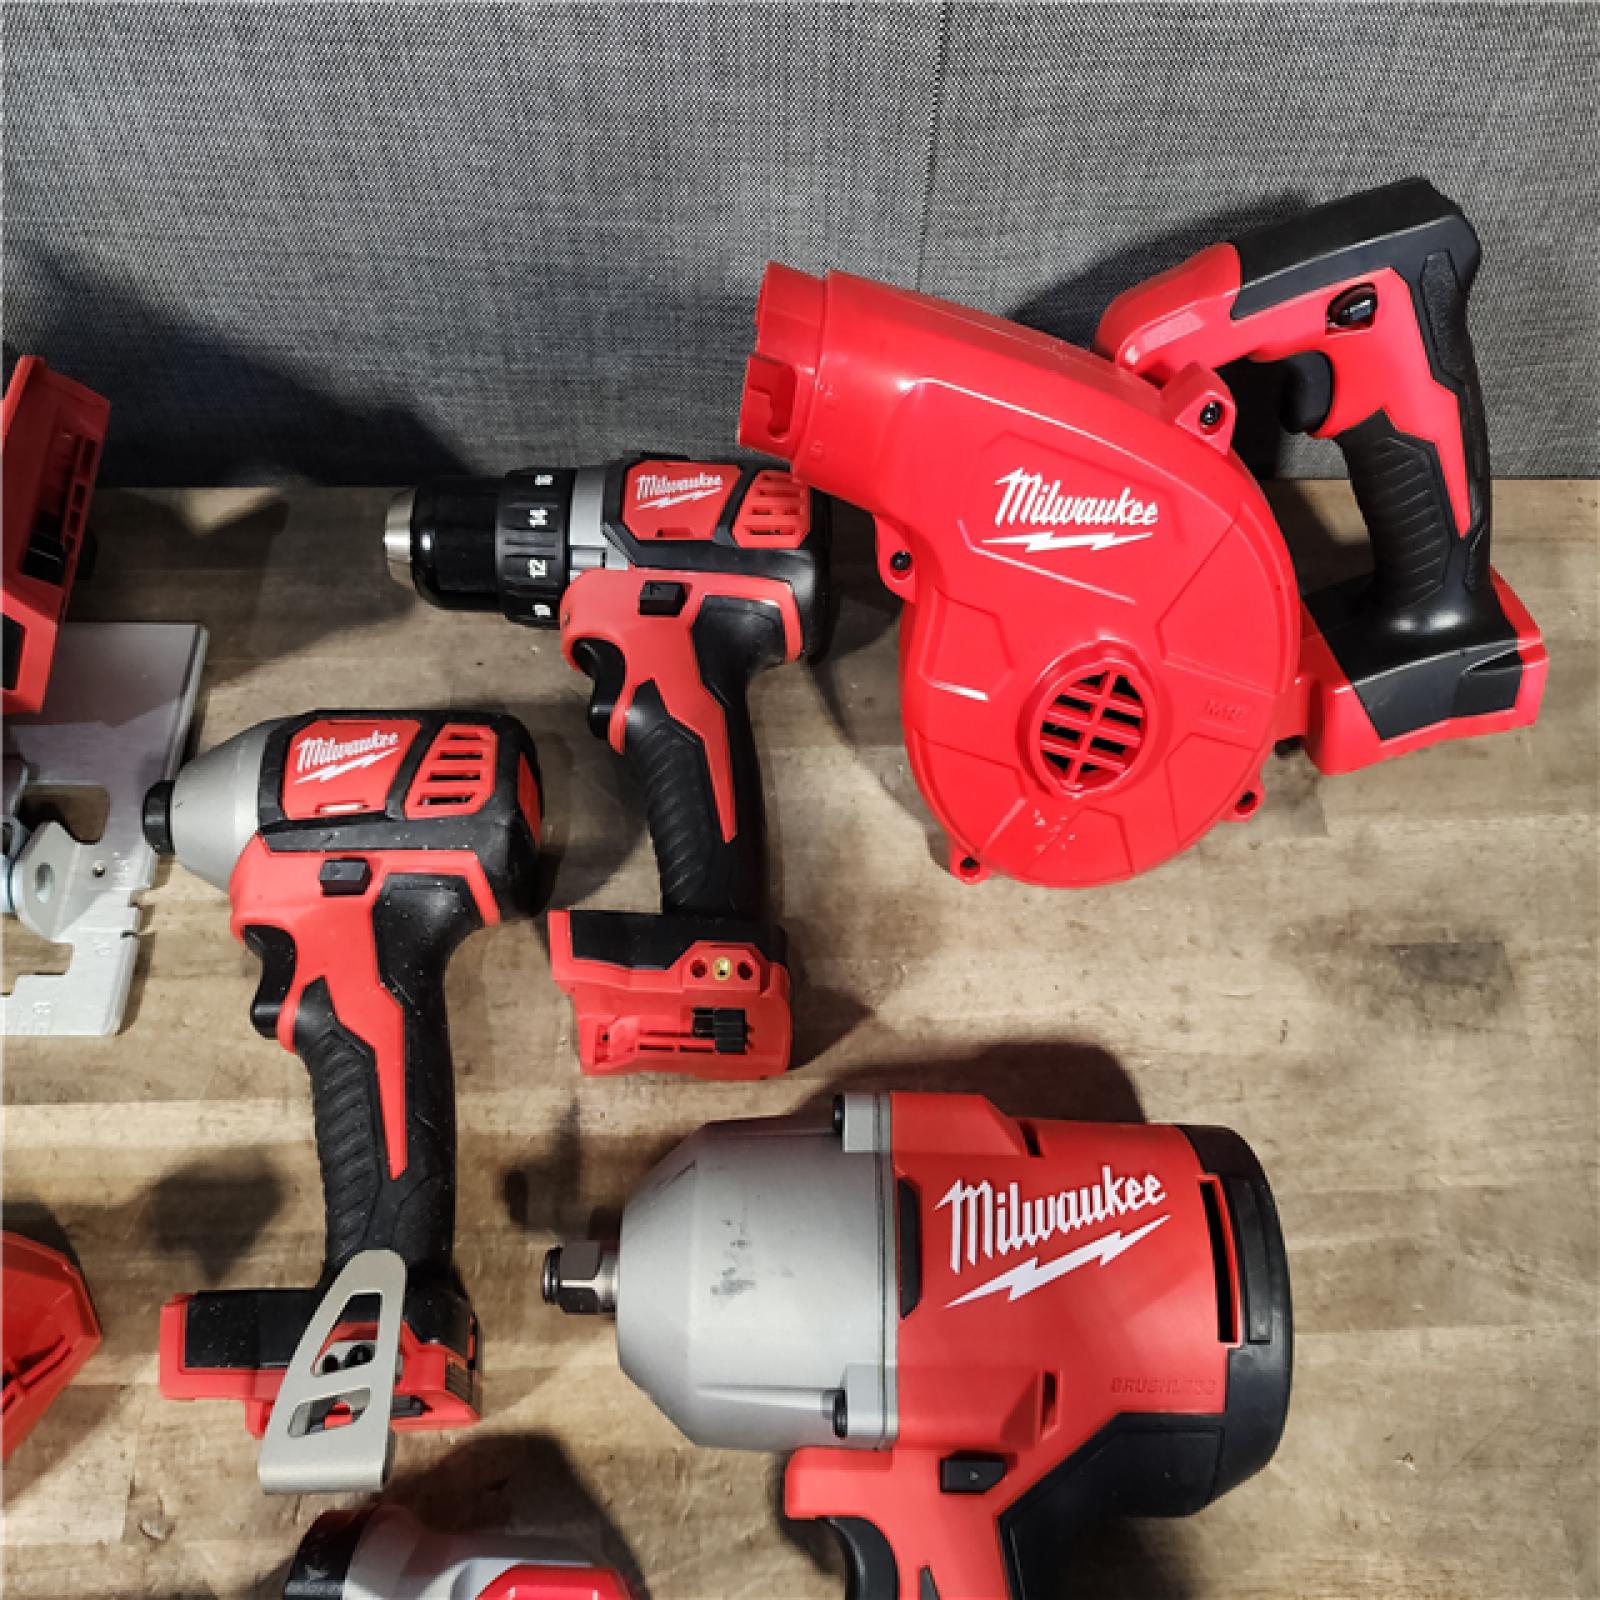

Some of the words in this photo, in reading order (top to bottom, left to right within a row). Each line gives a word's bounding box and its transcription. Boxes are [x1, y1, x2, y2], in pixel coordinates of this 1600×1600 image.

[635, 472, 723, 500] Milwaukee
[995, 467, 1159, 526] Milwaukee
[296, 729, 399, 773] Milwaukee
[933, 1165, 1167, 1275] Milwaukee
